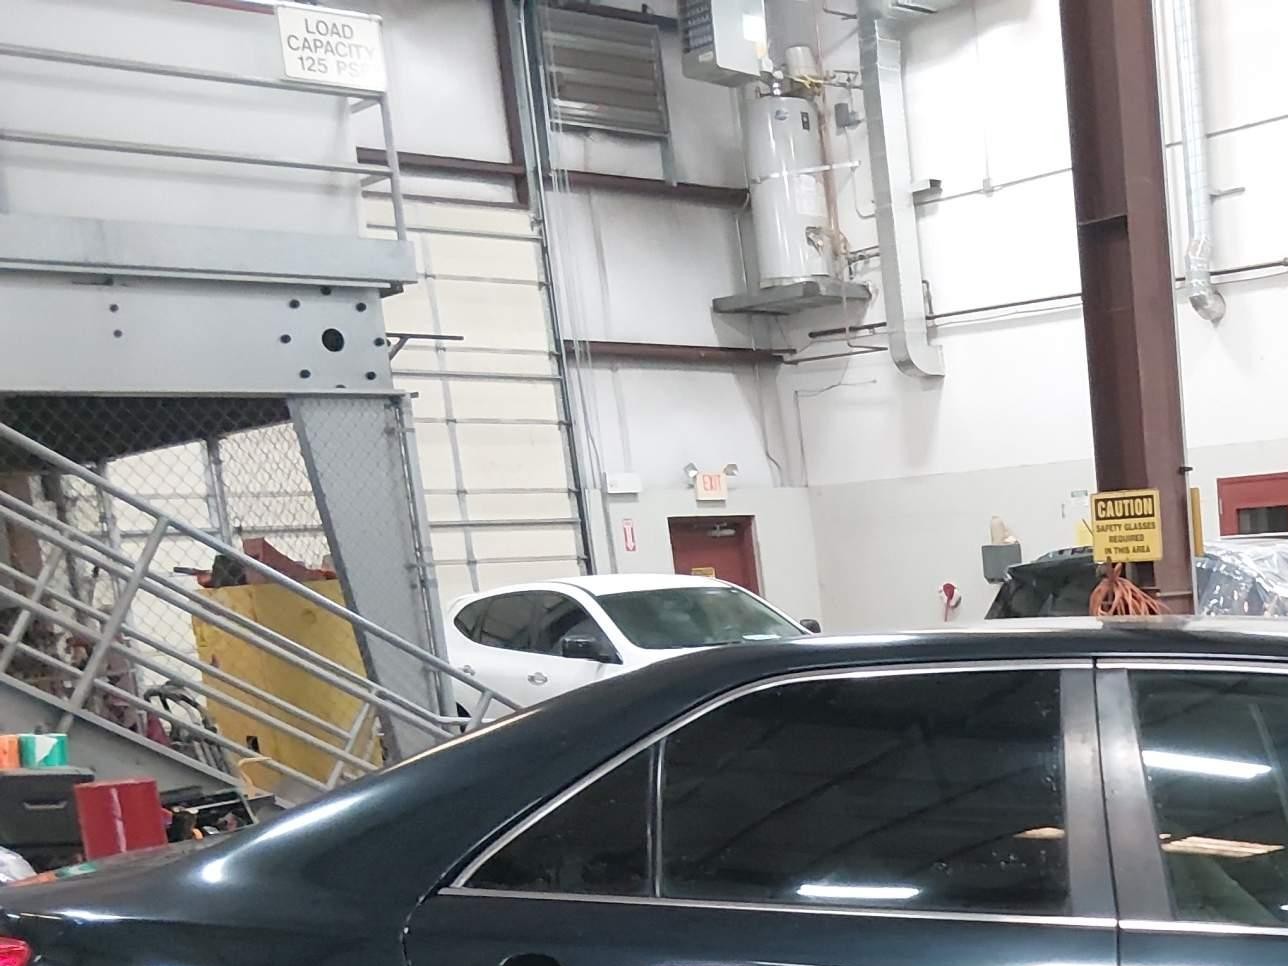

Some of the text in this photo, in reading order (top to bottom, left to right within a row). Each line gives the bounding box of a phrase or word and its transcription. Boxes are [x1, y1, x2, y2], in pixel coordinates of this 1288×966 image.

[304, 18, 354, 40] LOAD
[287, 34, 375, 61] CAPACITY
[297, 56, 328, 74] 125
[702, 474, 721, 491] EXIT
[1097, 497, 1153, 518] CAUTION
[1096, 521, 1156, 533] SAFETY GLASSES
[1109, 533, 1145, 543] REQUIRED
[1104, 544, 1151, 555] IN THIS AREA
